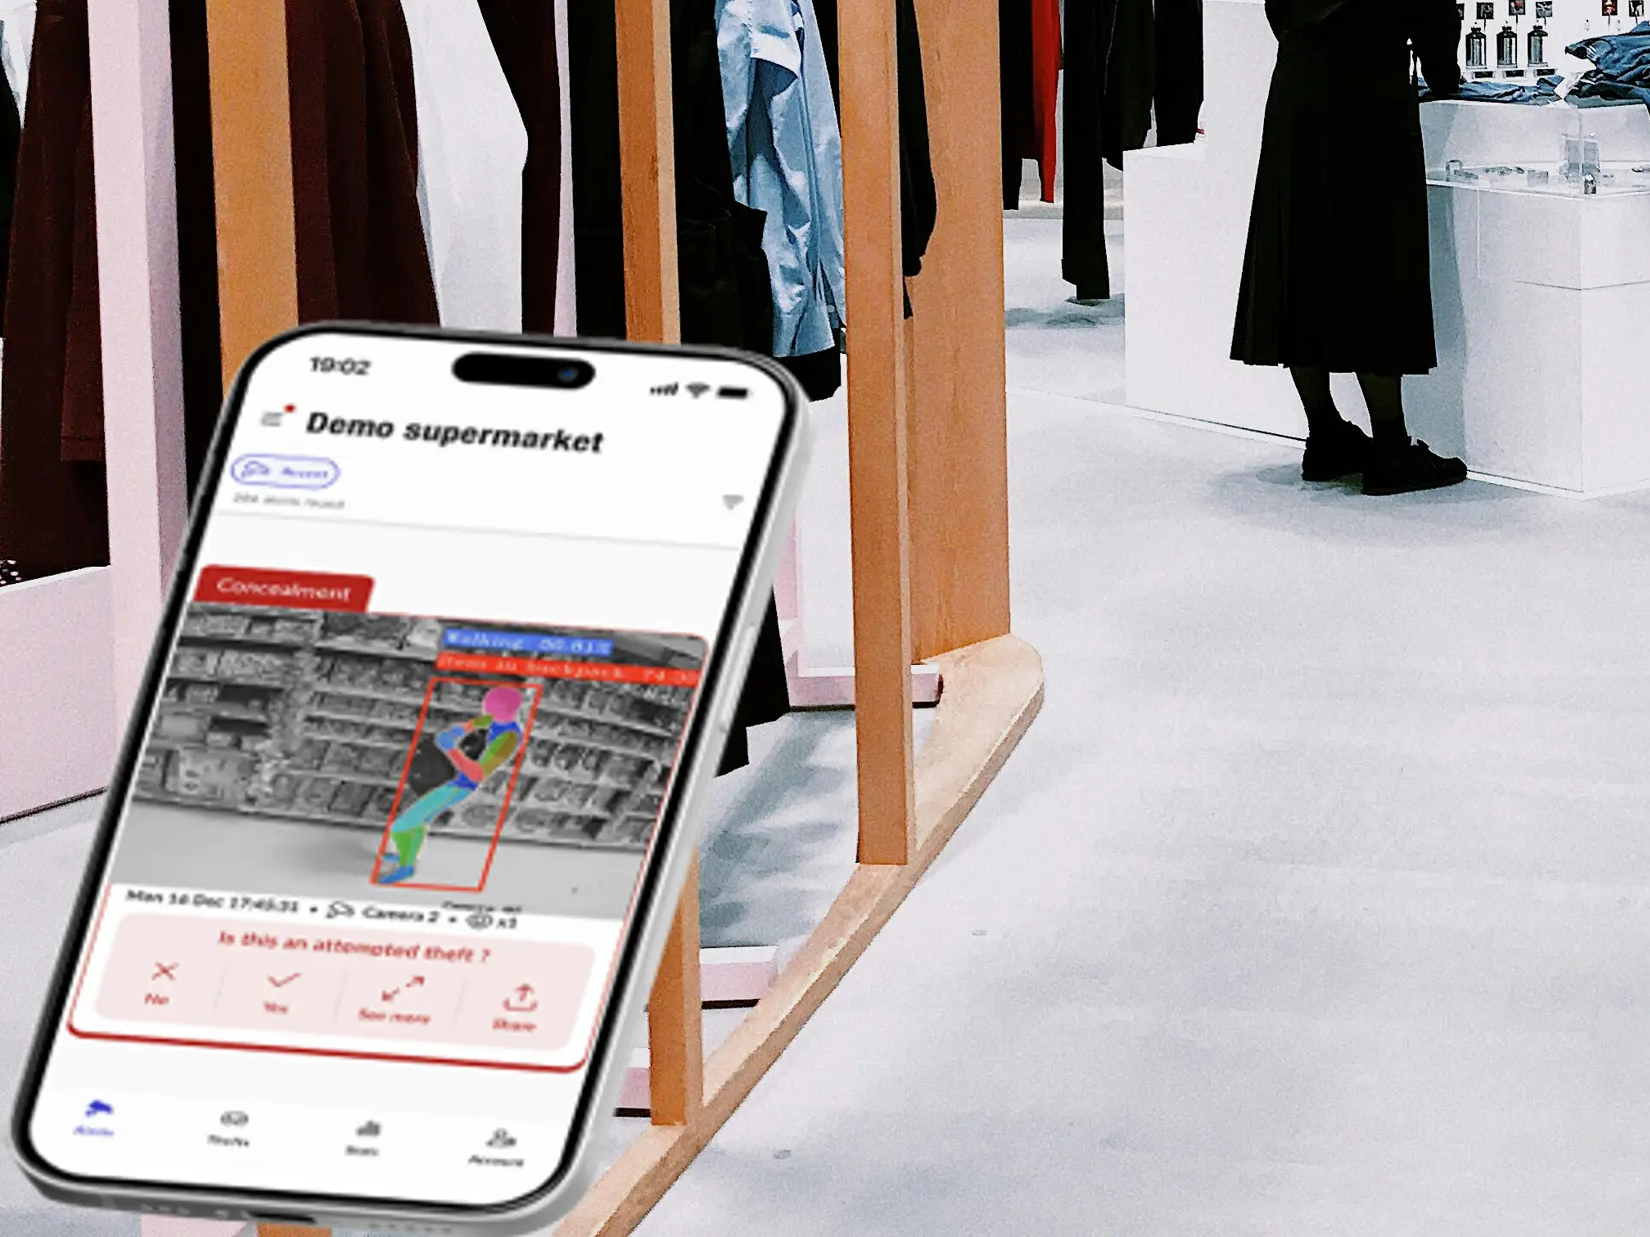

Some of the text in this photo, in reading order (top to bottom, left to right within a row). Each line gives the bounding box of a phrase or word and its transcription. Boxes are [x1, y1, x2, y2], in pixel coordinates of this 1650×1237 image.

[310, 356, 371, 376] 19:02
[306, 412, 604, 454] Demo supermarket
[216, 578, 351, 602] Concealment
[126, 889, 163, 903] Mon
[193, 893, 225, 908] Dec
[362, 905, 424, 922] Camera
[427, 911, 439, 923] 2
[218, 930, 491, 962] Is this an attempted theft ?
[144, 993, 170, 1005] No
